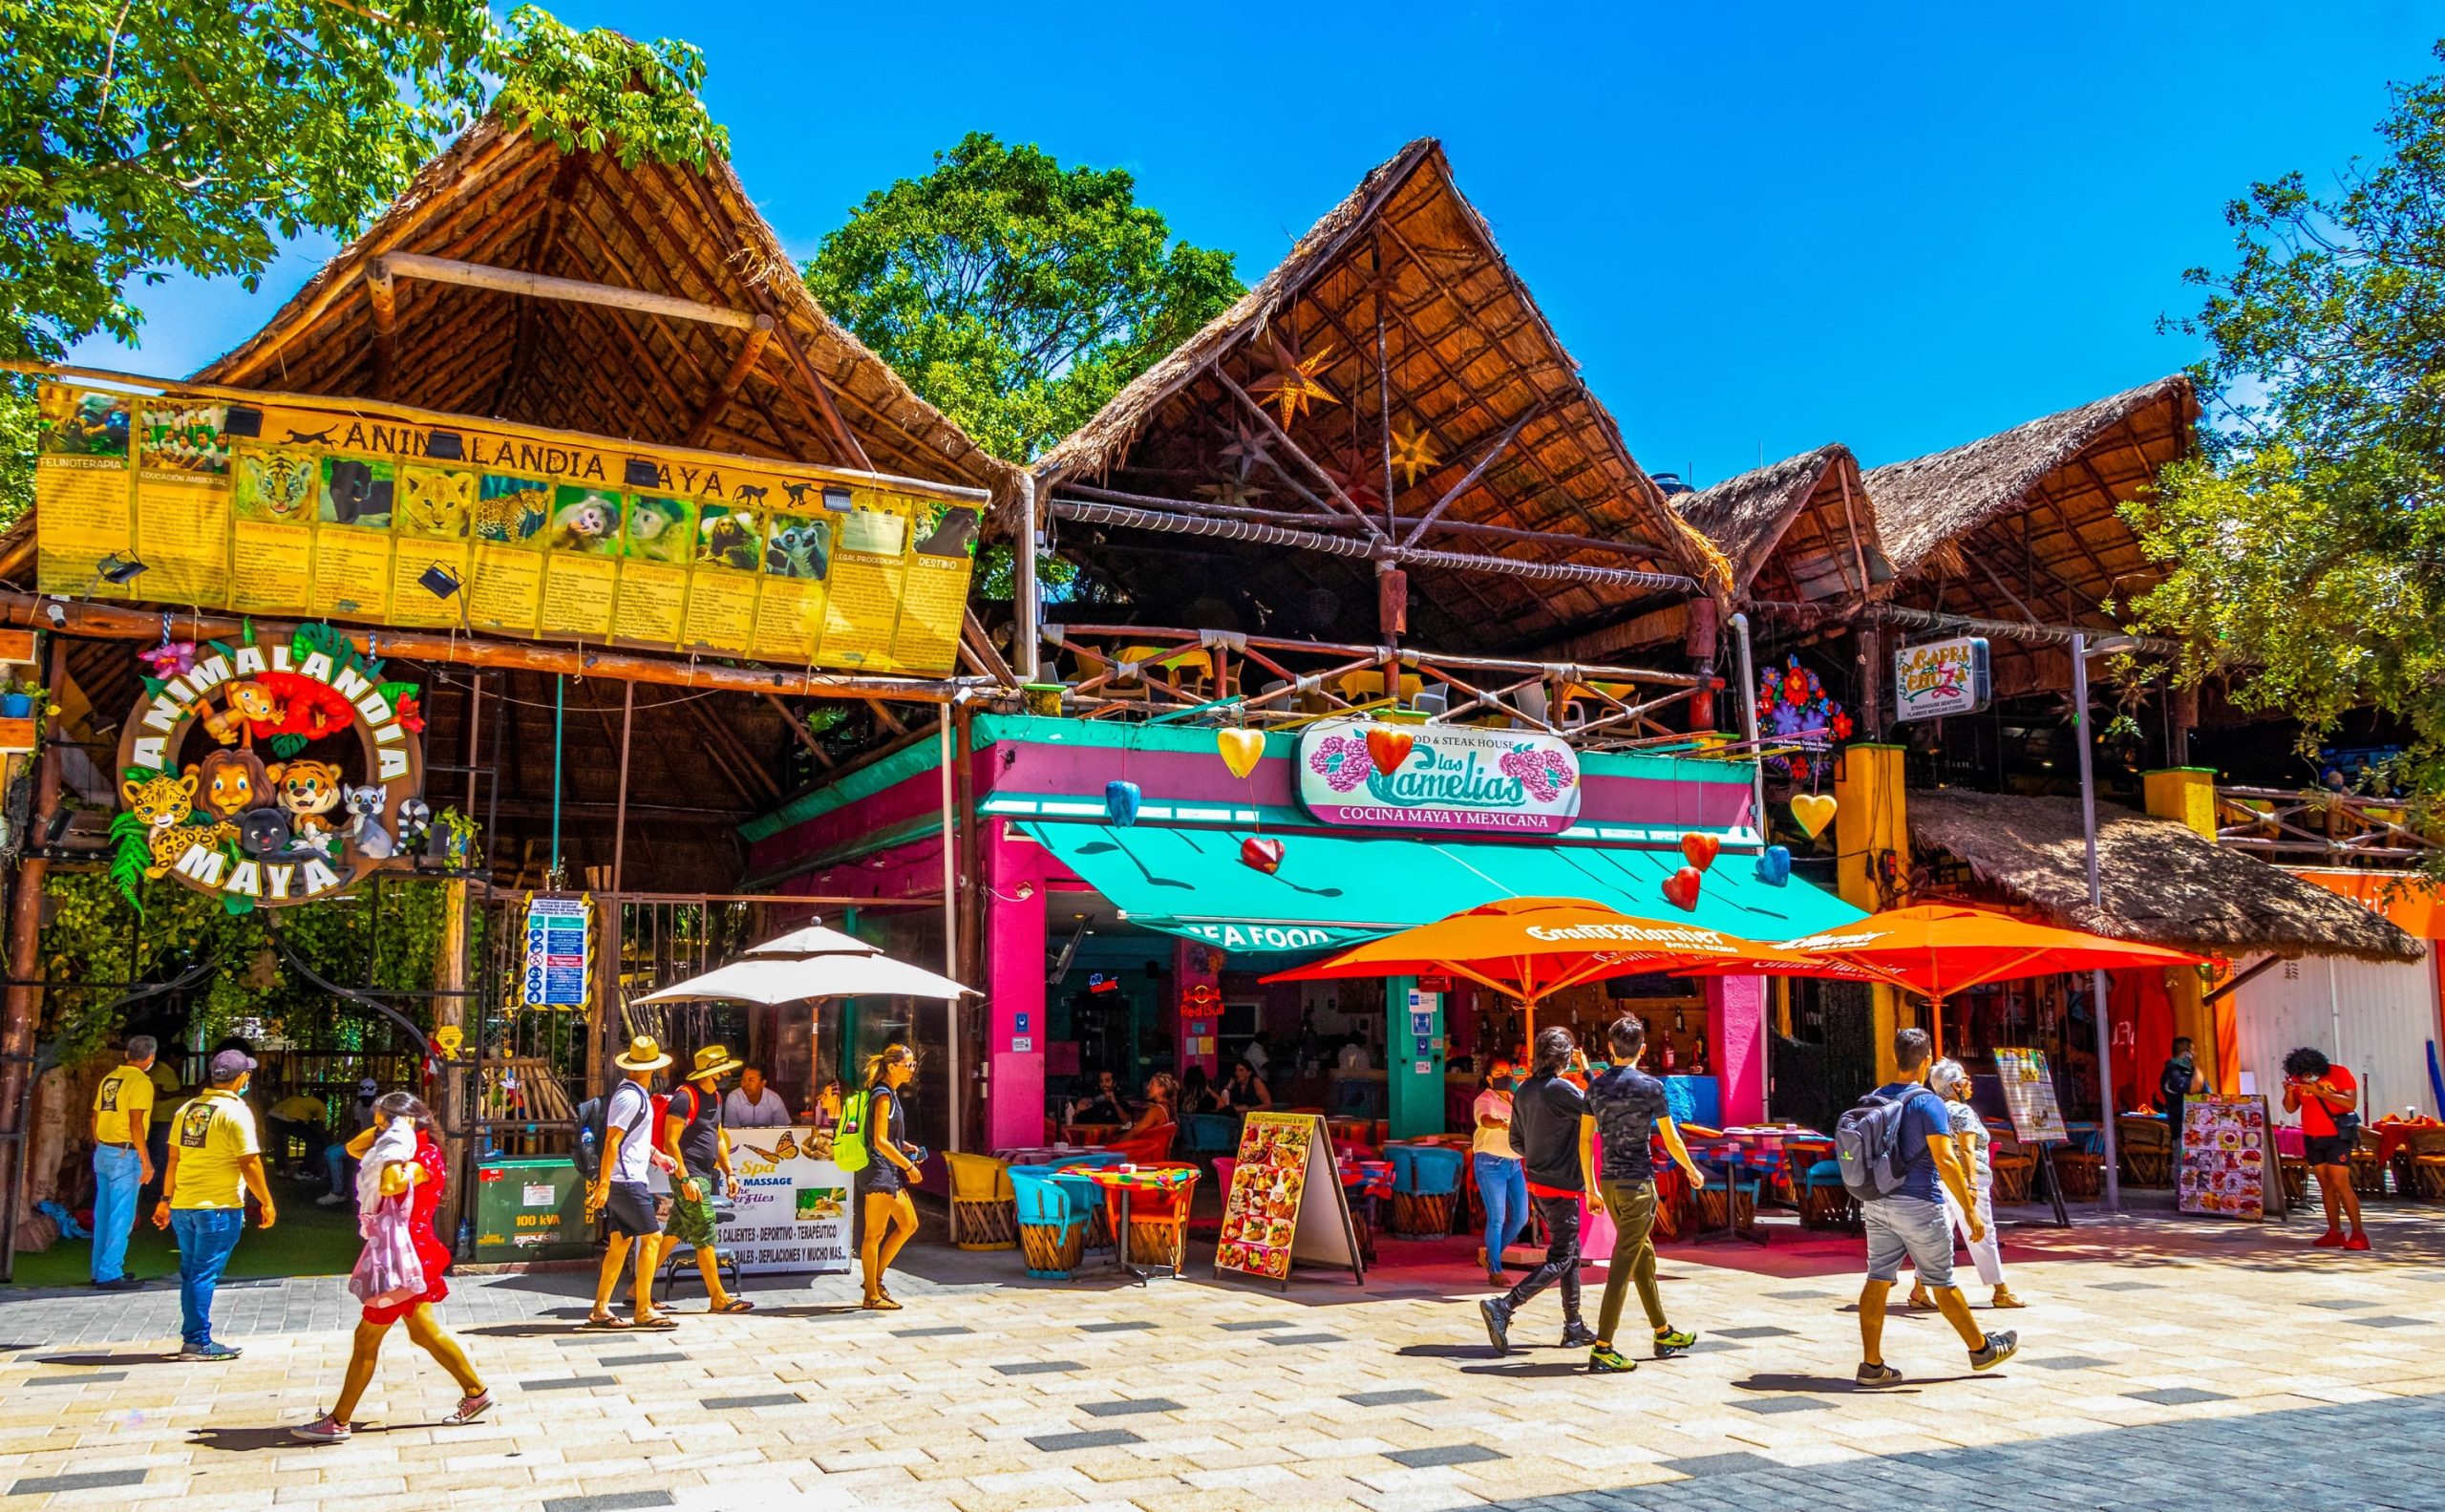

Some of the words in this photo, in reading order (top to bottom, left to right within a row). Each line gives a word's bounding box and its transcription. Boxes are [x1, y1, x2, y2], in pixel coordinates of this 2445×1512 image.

[39, 457, 122, 470] FELINOTERAPIA
[343, 422, 606, 481] ANILANDIA
[625, 458, 724, 499] AYA
[185, 475, 227, 486] AMBIENTAL
[834, 553, 856, 563] LEGAL
[856, 555, 904, 567] PROCEDENCIA
[918, 557, 957, 570] DESTINO
[1913, 645, 1969, 670] CAPRI
[132, 643, 410, 782] ANIMALANDIA
[1910, 701, 1940, 712] STEAKHOUSE
[1941, 698, 1963, 708] SEAFOOD
[1927, 707, 1948, 715] MEXICAN
[1442, 736, 1476, 747] STEAK
[1478, 738, 1515, 750] HOUSE
[1437, 753, 1463, 771] las
[1339, 806, 1405, 822] COCINA
[1408, 809, 1454, 824] MAYA
[1455, 812, 1463, 824] Y
[1466, 812, 1549, 828] MEXICANA
[173, 841, 341, 900] MAYA
[1247, 926, 1329, 948] FOOD
[1180, 1004, 1201, 1017] Red
[1203, 1003, 1224, 1016] Bull
[739, 1160, 776, 1177] Spa
[743, 1177, 793, 1187] MASSAGE
[516, 1215, 537, 1226] 100
[540, 1214, 561, 1225] kVA
[723, 1227, 755, 1243] CALIENTES
[760, 1226, 793, 1241] DEPORTIVO
[797, 1223, 837, 1240] TERAPÉUTICO
[758, 1247, 800, 1263] DEPILACIONES
[801, 1247, 806, 1262] Y
[807, 1246, 829, 1261] MUCHO
